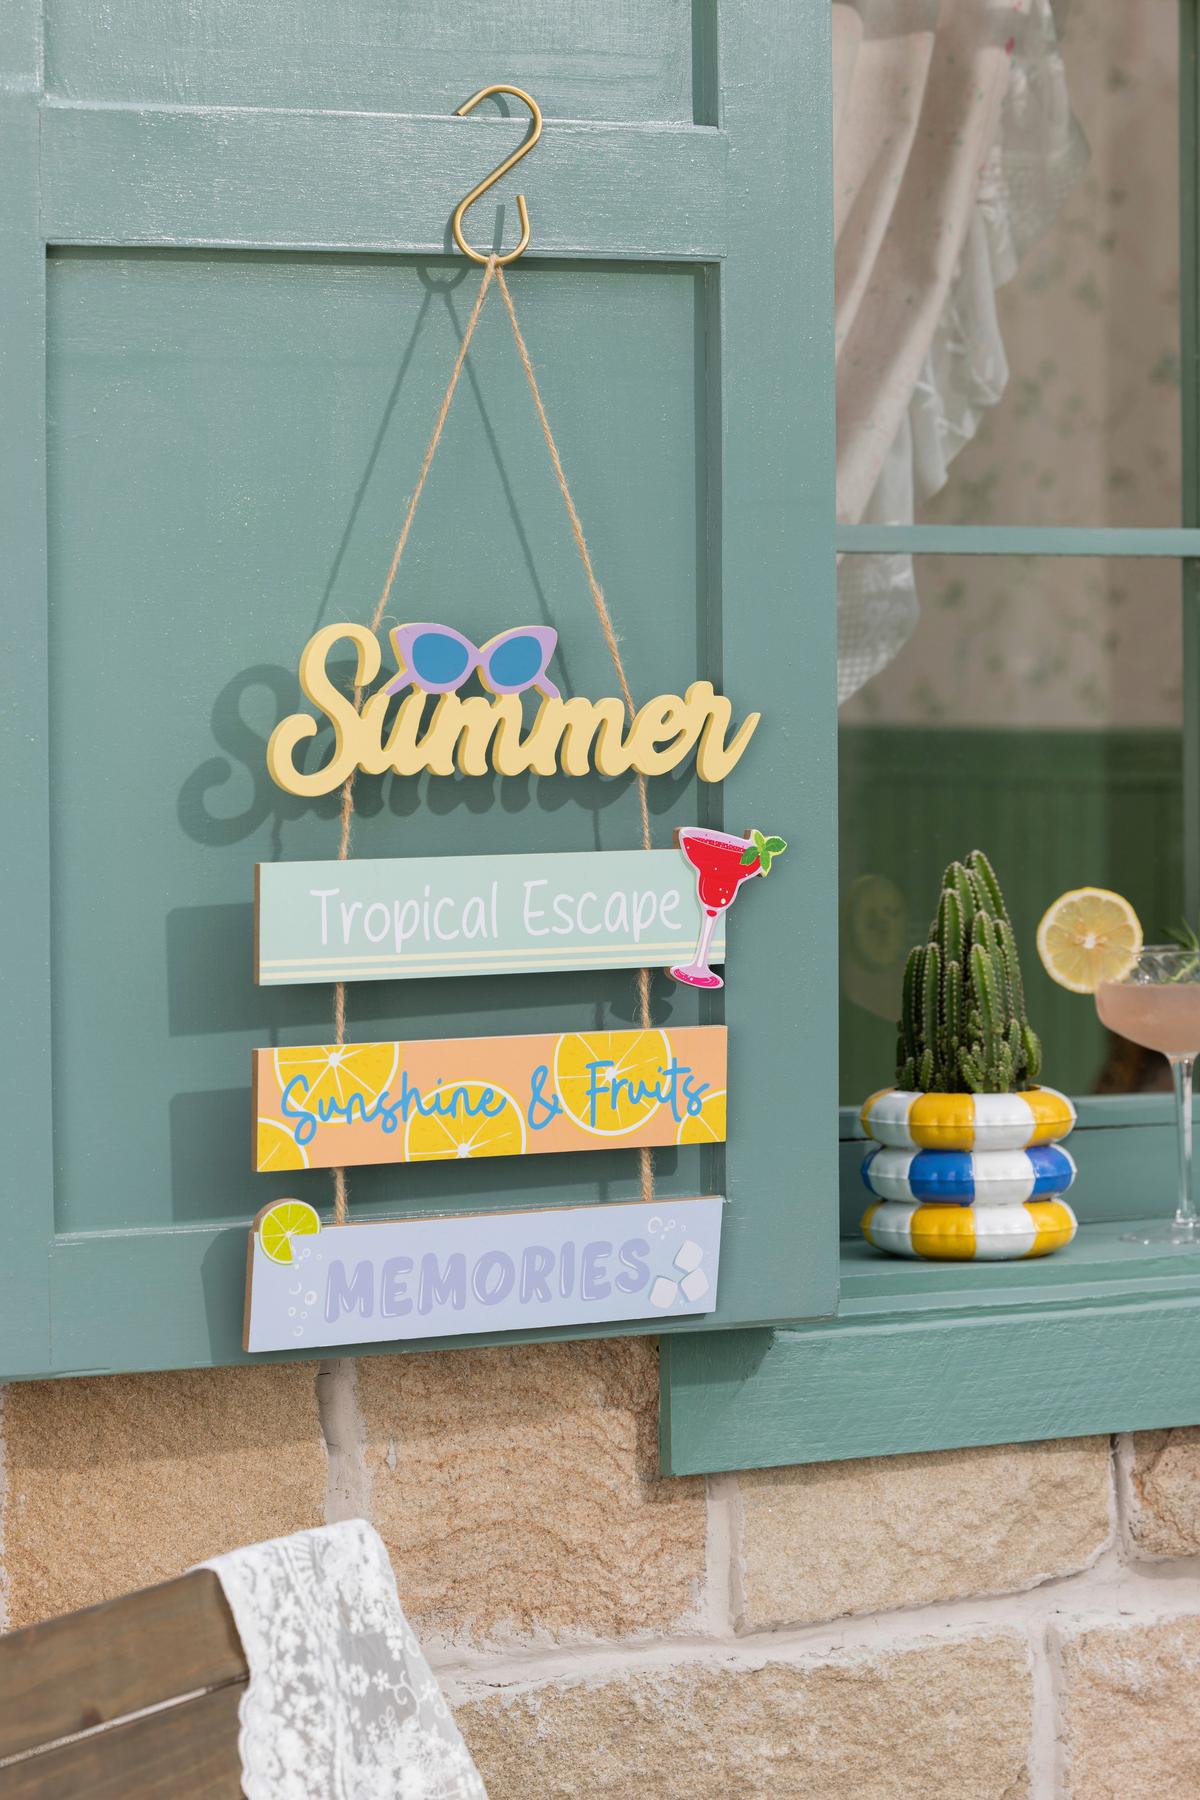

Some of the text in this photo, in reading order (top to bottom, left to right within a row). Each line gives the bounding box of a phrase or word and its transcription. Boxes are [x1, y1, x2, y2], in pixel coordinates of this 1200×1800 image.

[267, 623, 761, 797] Summer
[310, 880, 682, 953] Tropical Escape
[281, 1057, 709, 1145] Sunshine & Fruits
[324, 1238, 651, 1323] MEMORIES
